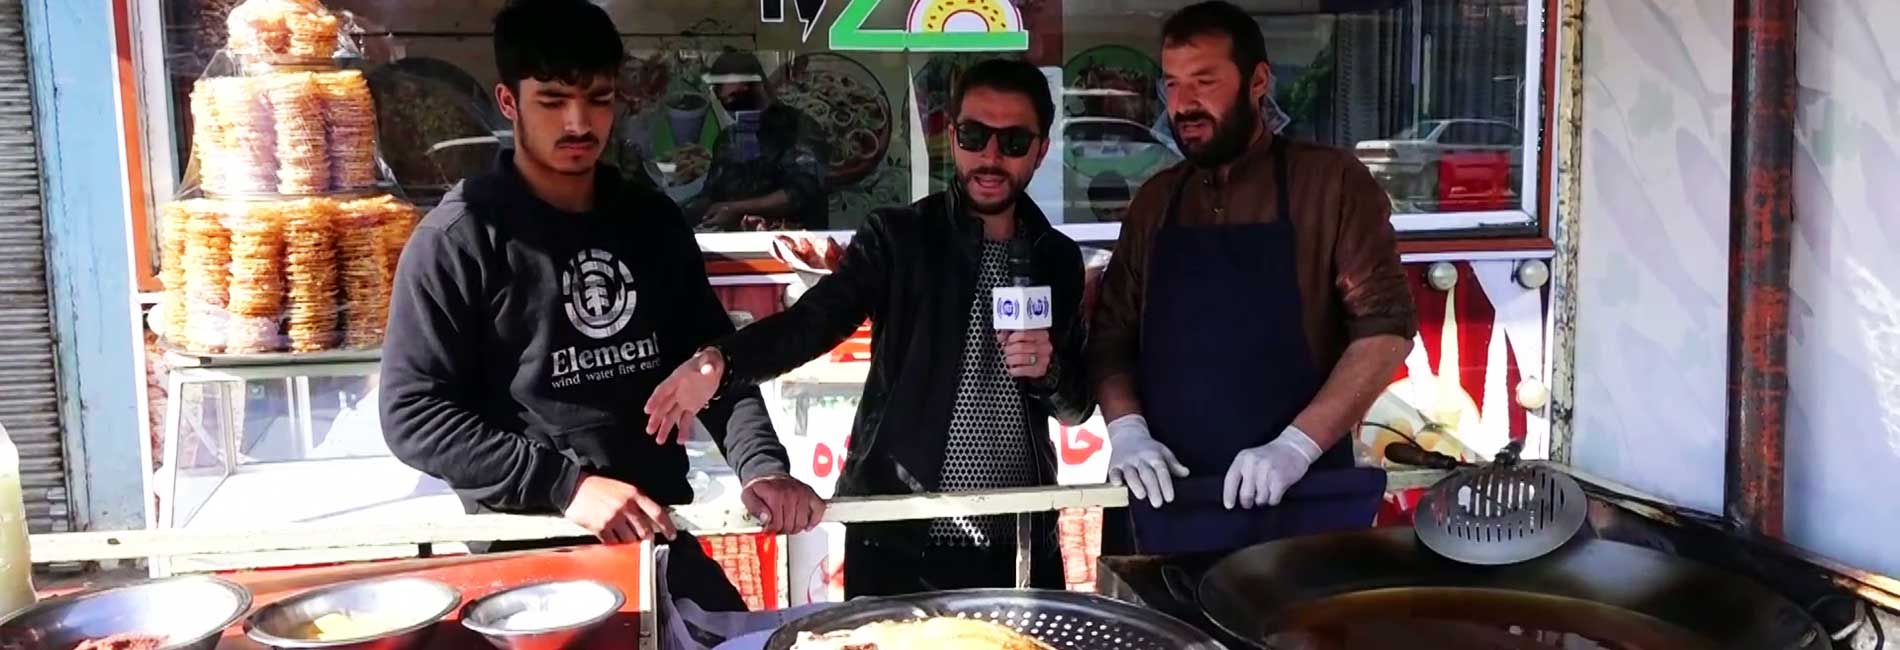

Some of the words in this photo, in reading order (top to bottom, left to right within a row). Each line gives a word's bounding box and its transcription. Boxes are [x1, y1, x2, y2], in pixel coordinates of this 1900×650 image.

[551, 373, 581, 389] wind
[586, 368, 615, 381] water
[619, 364, 637, 375] fire
